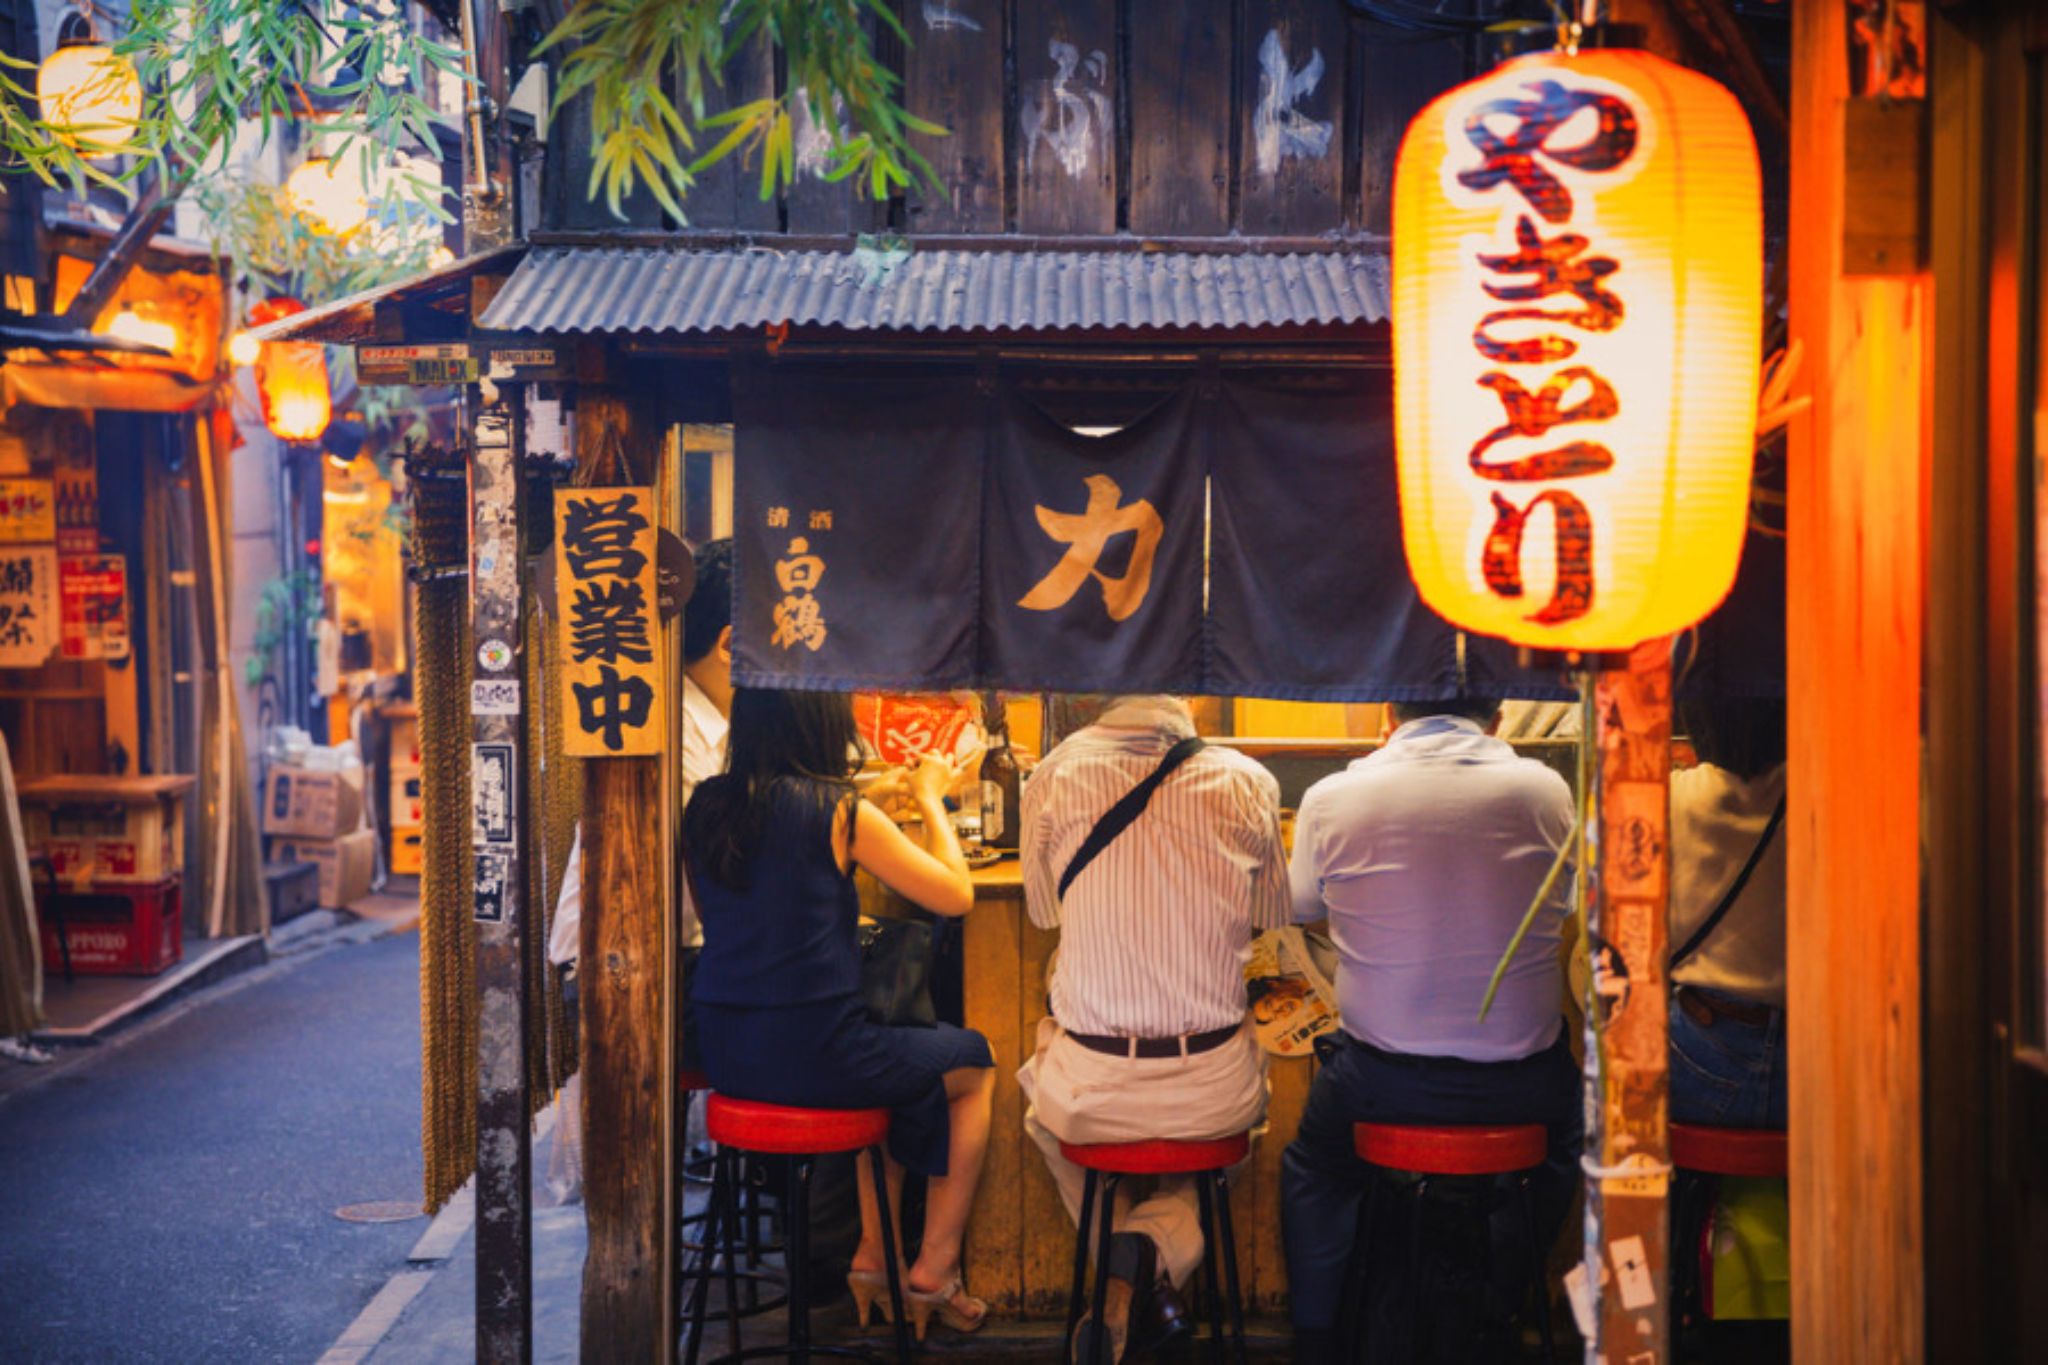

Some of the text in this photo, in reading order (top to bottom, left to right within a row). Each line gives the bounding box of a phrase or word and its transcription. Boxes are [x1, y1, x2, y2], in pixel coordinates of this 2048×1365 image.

[1457, 79, 1639, 626] やきとり
[563, 493, 653, 751] 営業中
[771, 537, 828, 652] 白鶴
[1016, 474, 1164, 622] 力
[53, 933, 128, 951] APPORO
